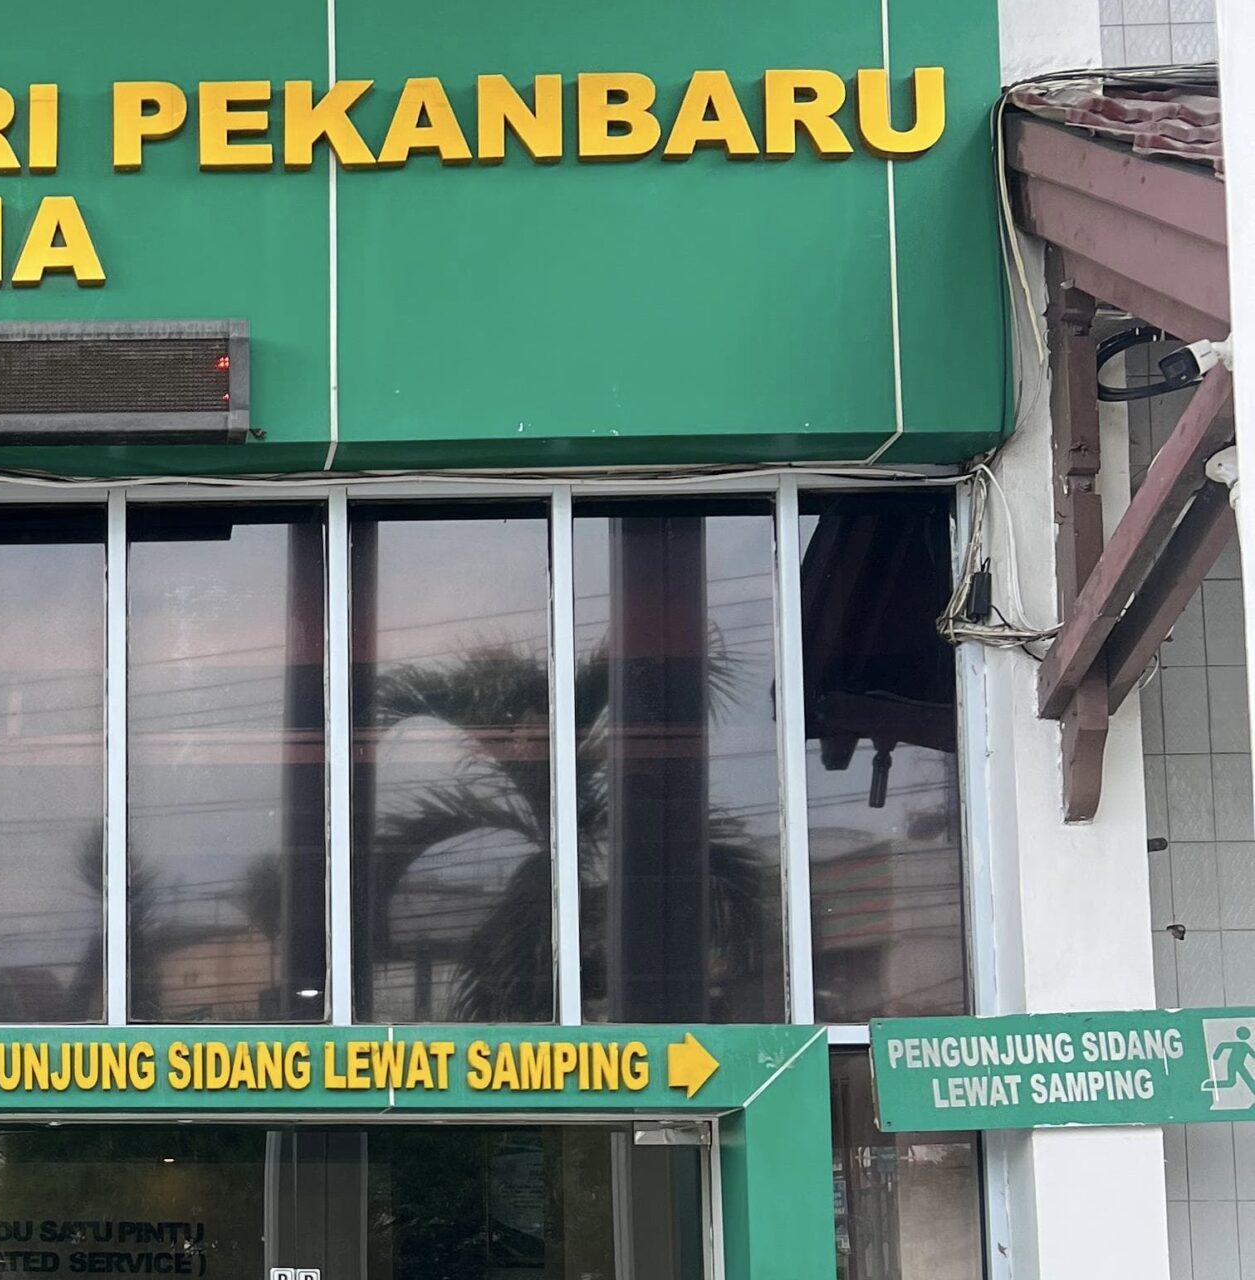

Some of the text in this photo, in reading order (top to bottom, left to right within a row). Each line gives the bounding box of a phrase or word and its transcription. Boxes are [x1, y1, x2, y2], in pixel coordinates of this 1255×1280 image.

[113, 67, 947, 172] PEKANBARU
[167, 1040, 312, 1091] SIDANG
[323, 1040, 456, 1090] LEWAT
[467, 1040, 649, 1092] SAMPING
[887, 1028, 1184, 1069] PENGUNJUNG SIDANG
[932, 1069, 1154, 1108] LEWAT SAMPING
